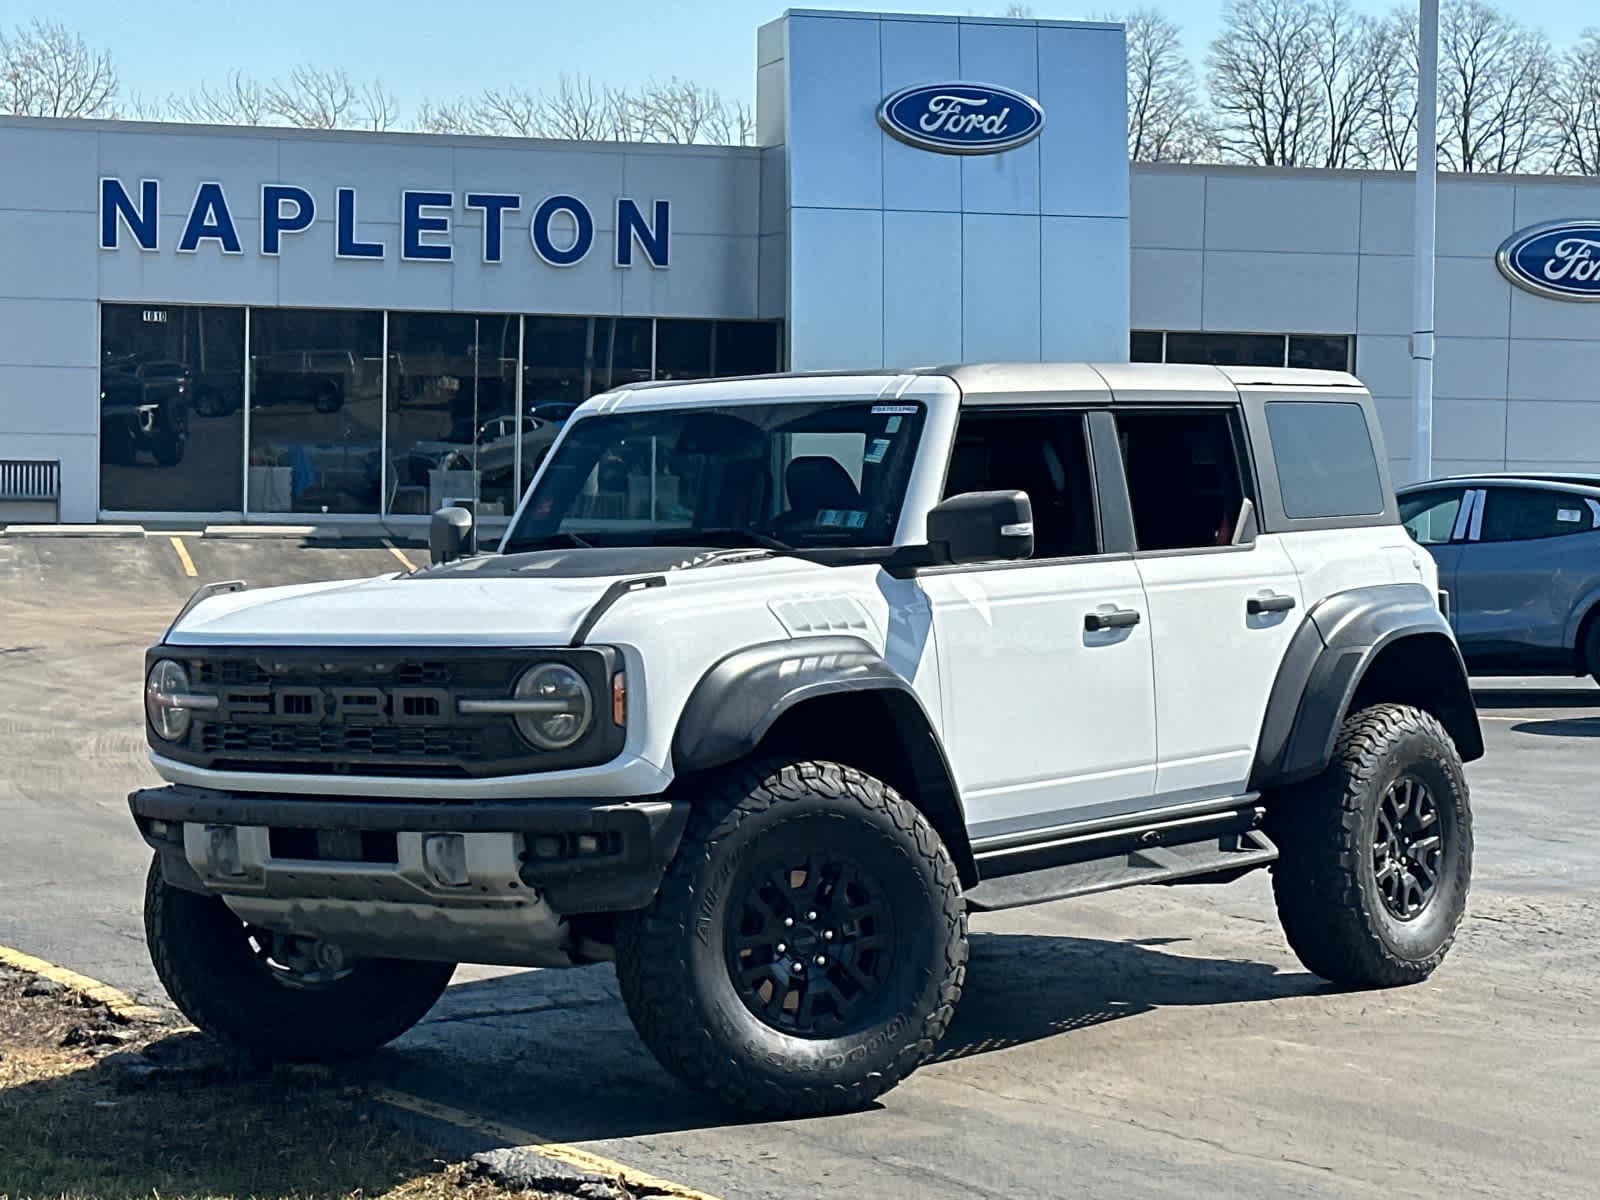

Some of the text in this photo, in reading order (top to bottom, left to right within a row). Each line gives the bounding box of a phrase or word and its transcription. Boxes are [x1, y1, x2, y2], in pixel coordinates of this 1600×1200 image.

[919, 95, 1010, 134] Ford
[99, 177, 671, 269] NAPLETON
[1544, 238, 1600, 281] Fo
[220, 686, 451, 726] FORD
